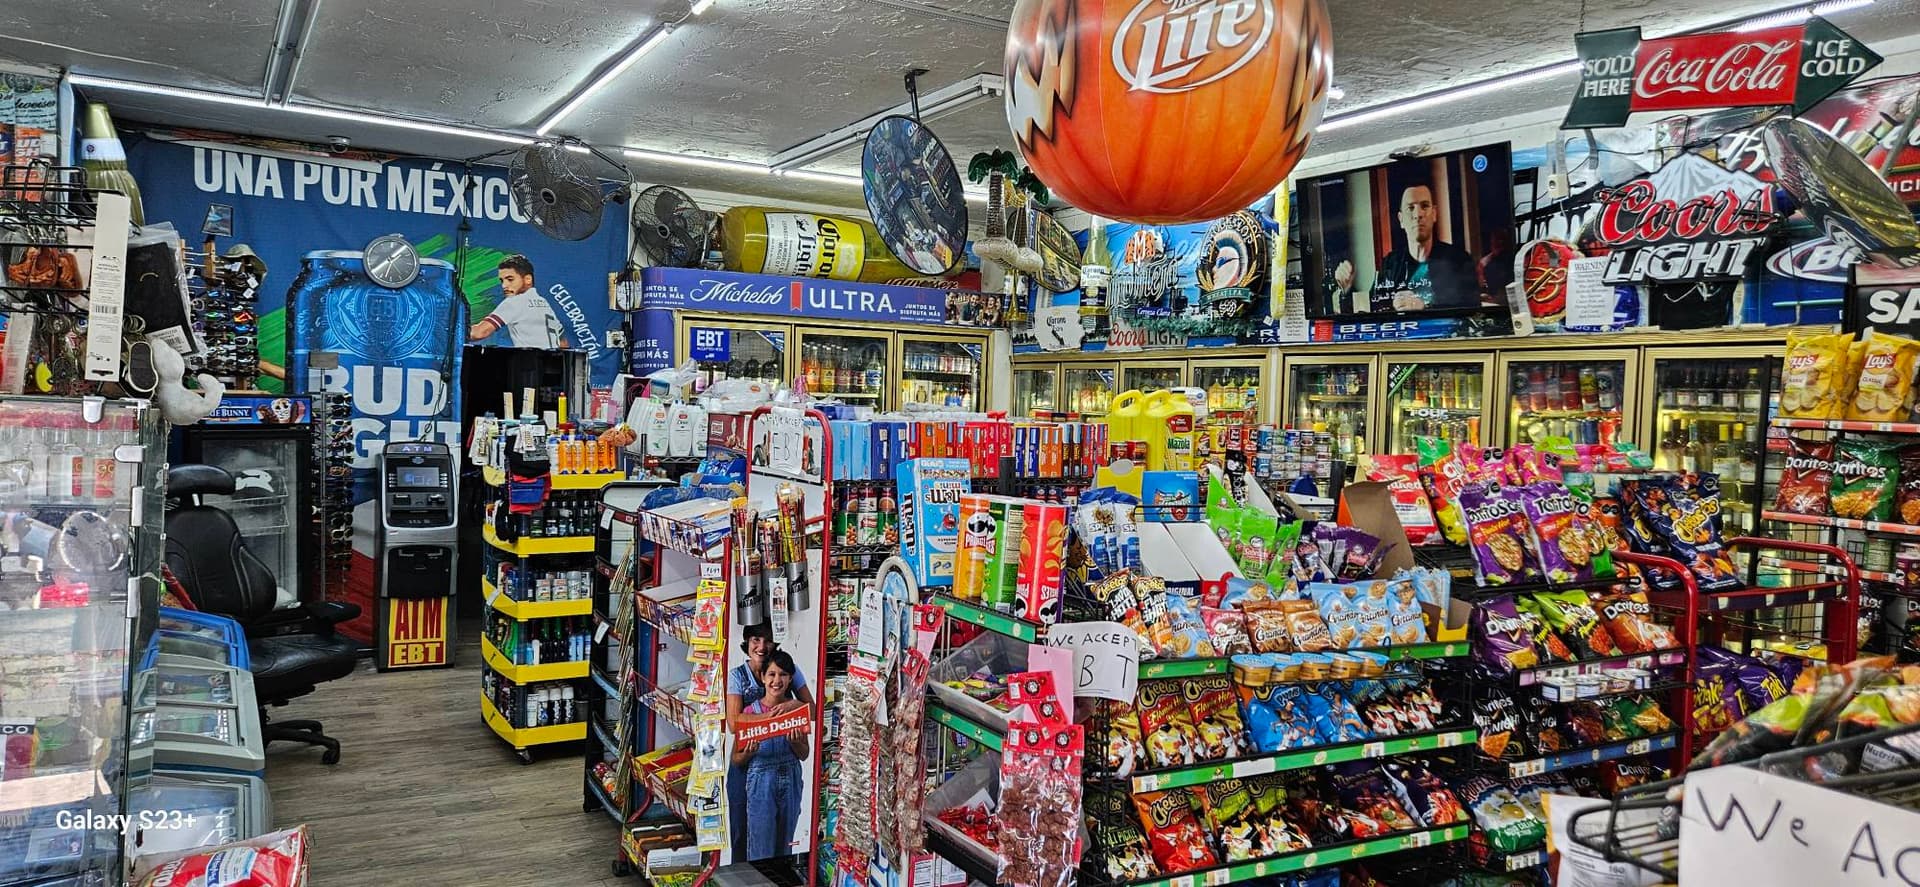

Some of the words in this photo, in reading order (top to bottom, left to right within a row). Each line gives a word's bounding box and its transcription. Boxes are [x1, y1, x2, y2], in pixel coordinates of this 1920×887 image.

[1127, 1, 1256, 92] Lite
[1815, 39, 1851, 58] ICE
[1584, 55, 1636, 77] SOLD
[1635, 40, 1798, 98] Coca-Cola
[1801, 56, 1866, 78] COLD
[1583, 78, 1630, 97] HERE
[194, 148, 284, 199] UNA
[294, 160, 378, 208] POR
[1597, 179, 1778, 245] Coors
[1602, 238, 1764, 283] LIGHT
[690, 279, 783, 306] Michelob
[809, 287, 896, 314] ULTRA
[697, 330, 724, 347] EBT
[1107, 322, 1147, 347] Coors
[1340, 321, 1419, 334] BEER
[647, 348, 669, 359] MÁS
[1865, 352, 1894, 369] Lay's
[308, 365, 447, 417] BUD
[222, 408, 250, 417] BUNNY
[350, 418, 461, 471] GHT
[394, 598, 442, 640] ATM
[1604, 601, 1649, 619] Doritos
[394, 642, 441, 665] EBT
[738, 724, 768, 741] Little
[769, 716, 808, 732] Debbie
[1697, 786, 1809, 847] We
